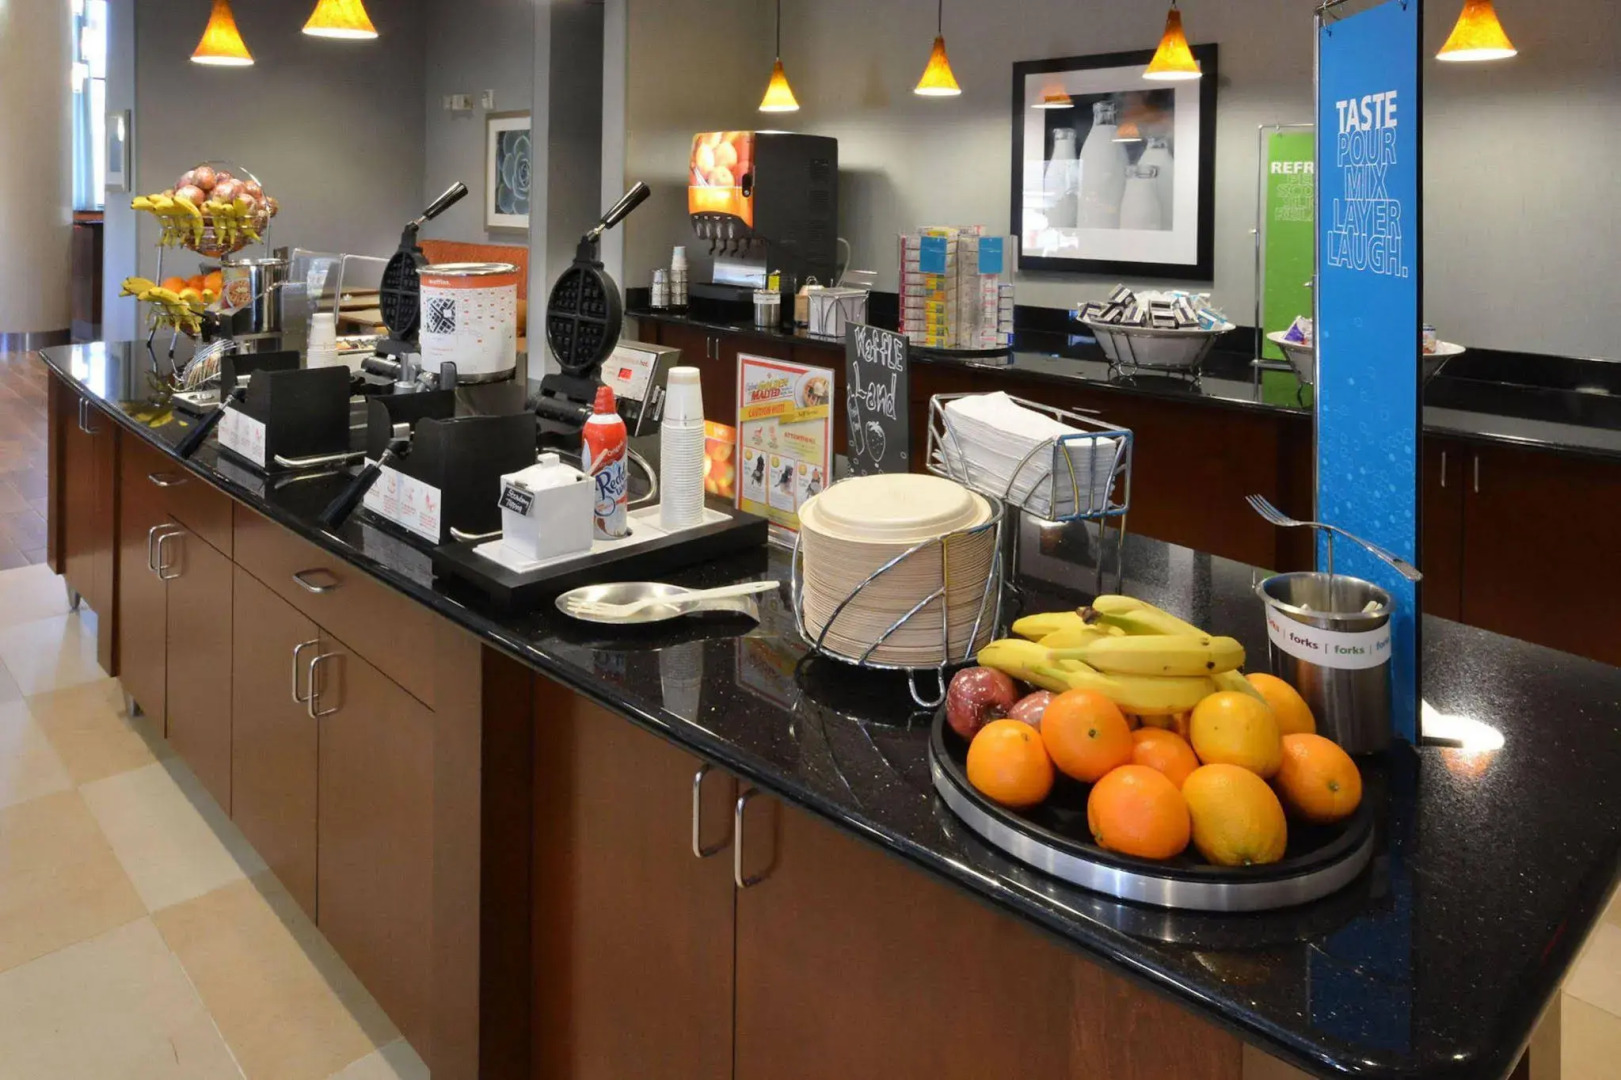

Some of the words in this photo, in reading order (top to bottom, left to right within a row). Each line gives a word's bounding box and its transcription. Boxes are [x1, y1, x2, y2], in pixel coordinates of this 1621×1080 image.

[1336, 90, 1398, 133] TASTE
[1337, 126, 1397, 167] POUR
[1344, 163, 1389, 201] MIX
[1333, 198, 1402, 239] LAYER
[1327, 230, 1409, 278] LAUGH.
[1289, 632, 1319, 649] forks
[1334, 644, 1365, 655] forks
